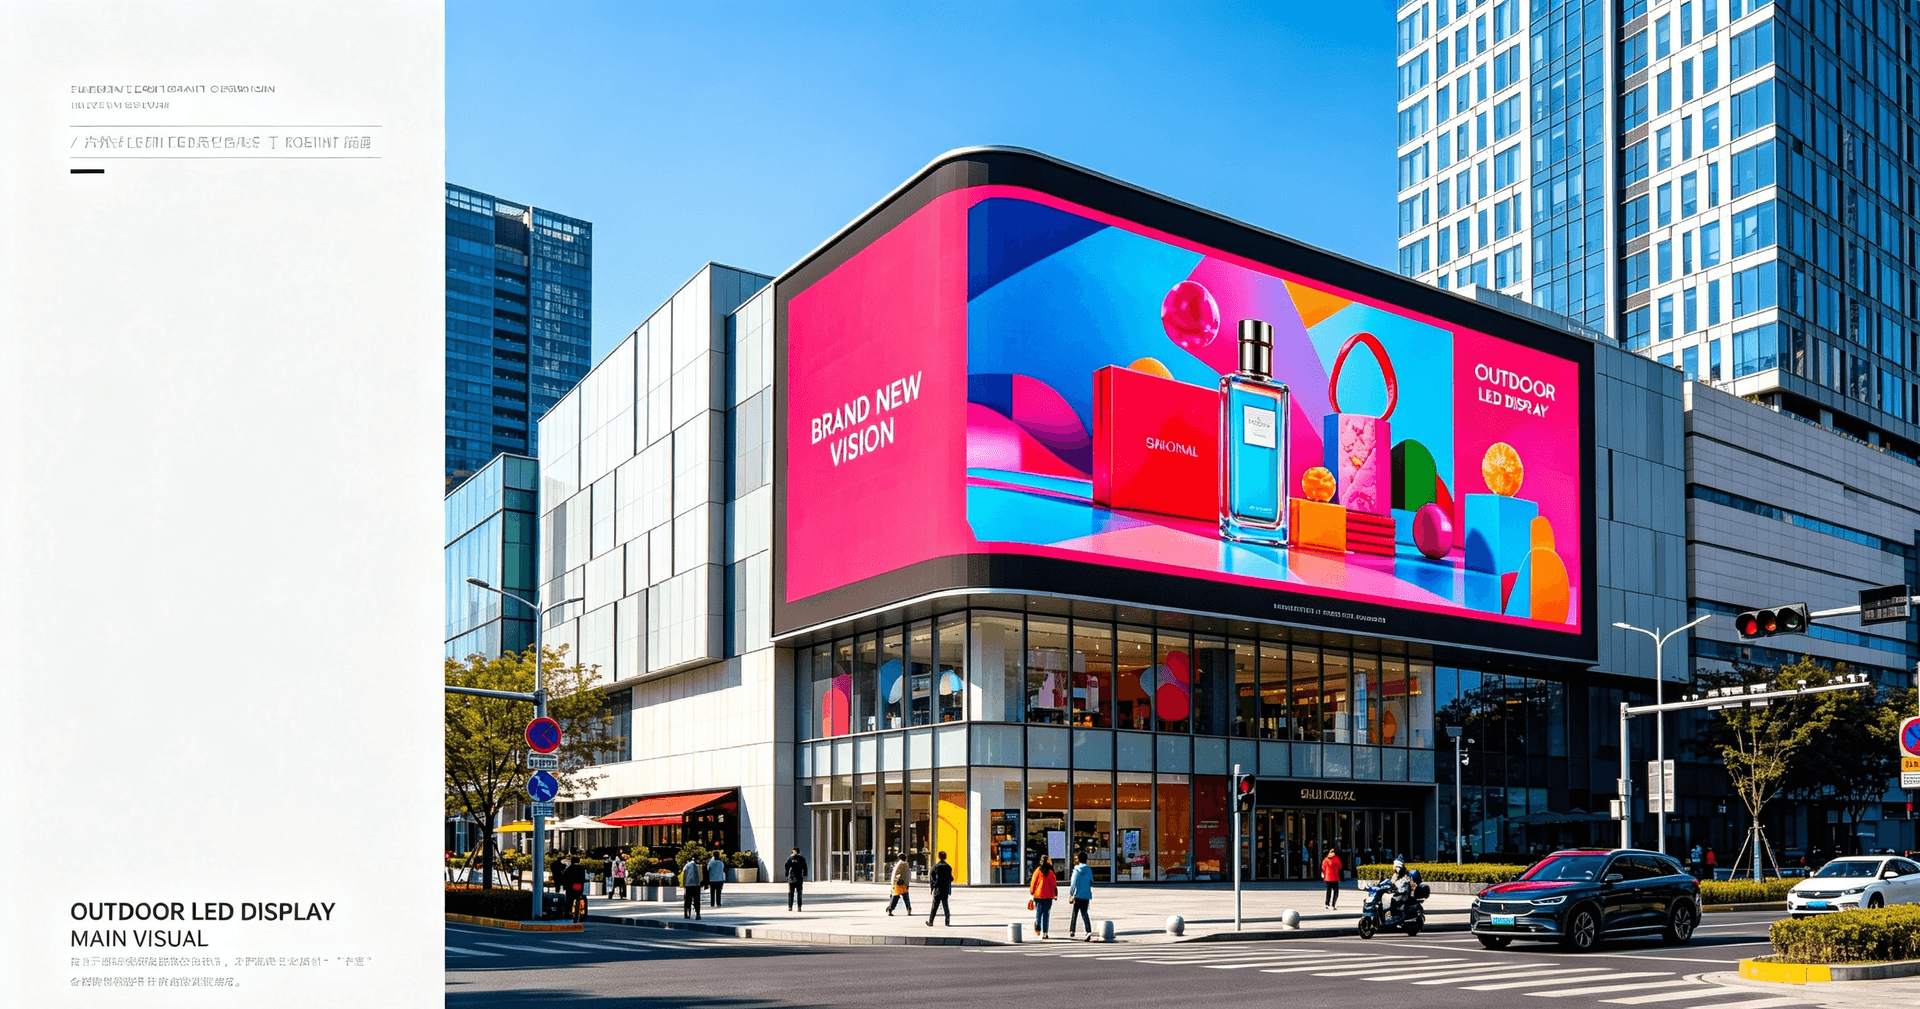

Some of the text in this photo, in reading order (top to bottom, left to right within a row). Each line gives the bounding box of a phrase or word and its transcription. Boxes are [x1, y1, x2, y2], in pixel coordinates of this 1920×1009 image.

[1474, 363, 1556, 402] OUTDOOR
[1478, 386, 1502, 406] LED
[811, 370, 923, 445] BRAND NEW
[829, 416, 895, 467] VISION
